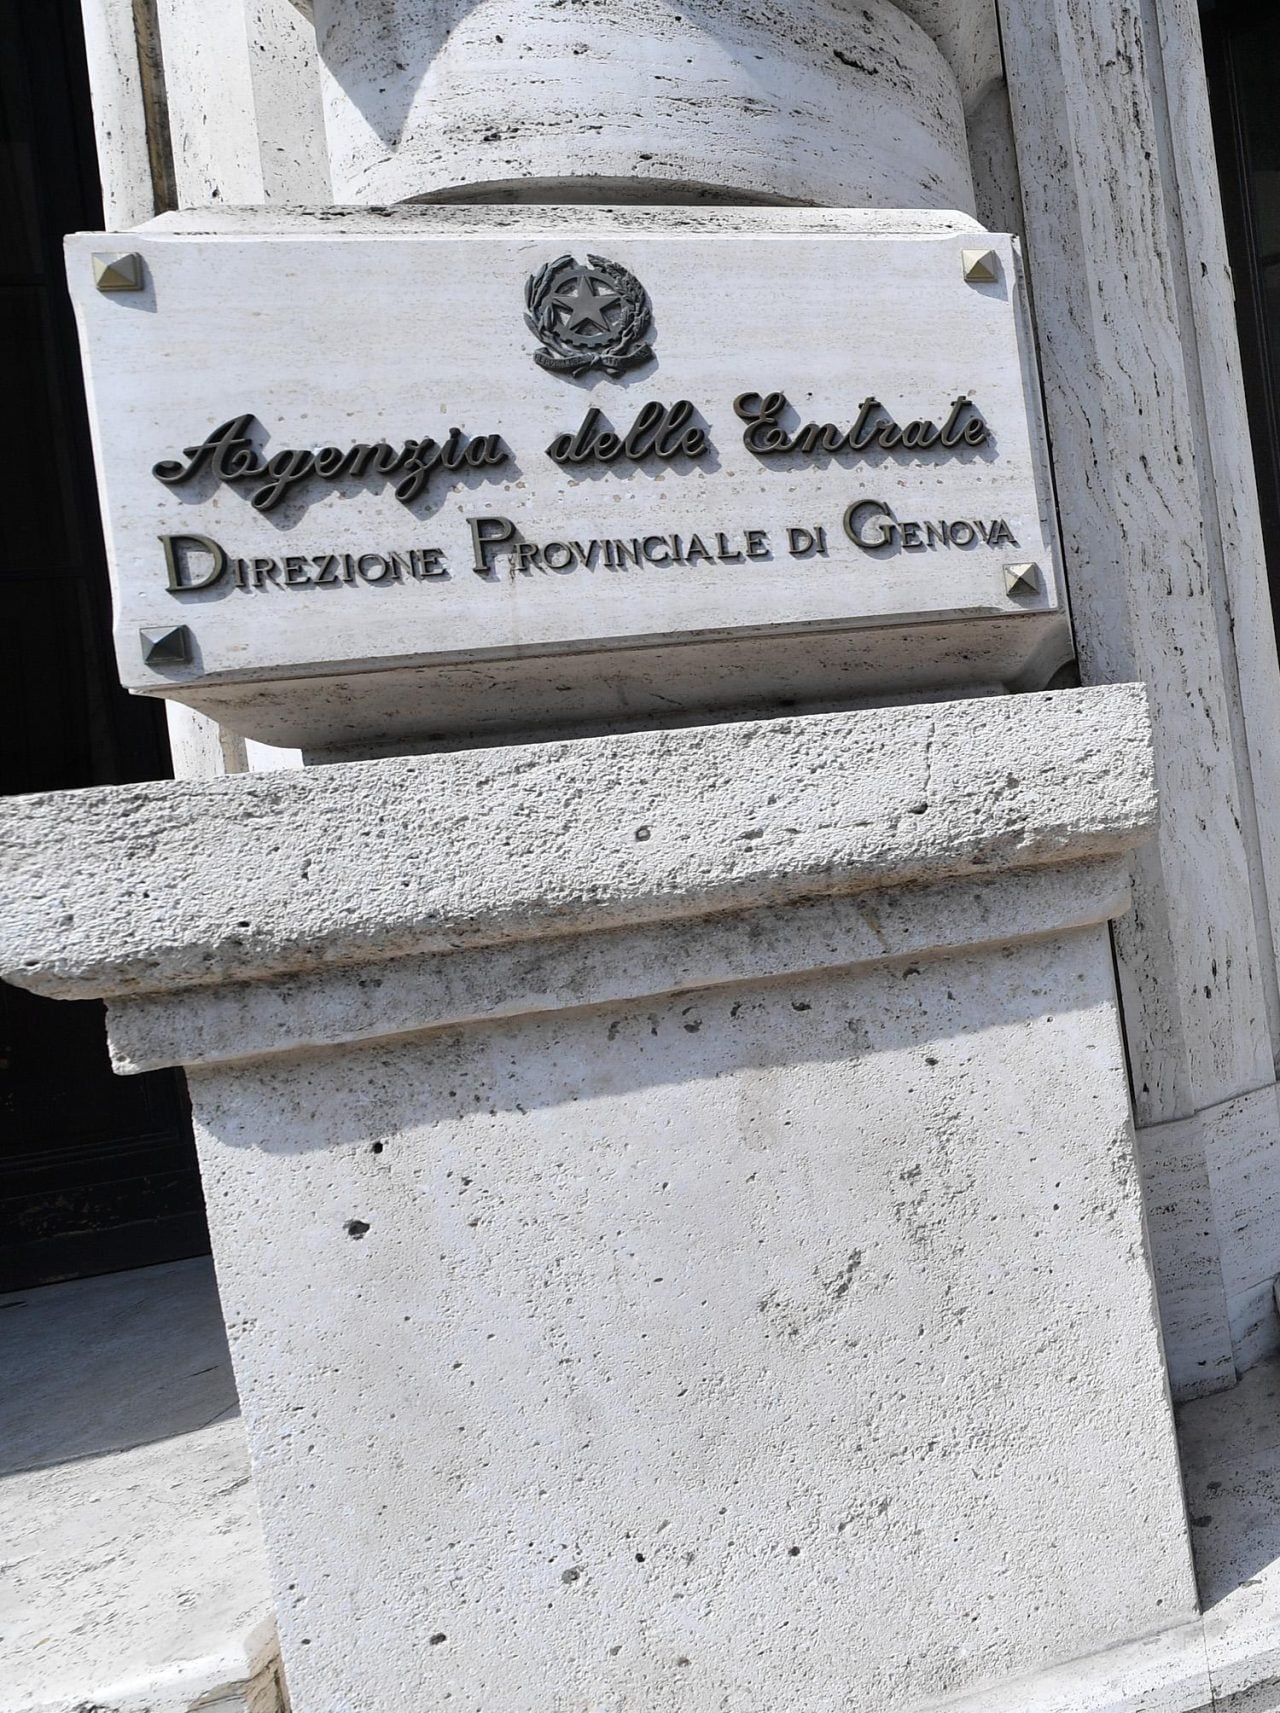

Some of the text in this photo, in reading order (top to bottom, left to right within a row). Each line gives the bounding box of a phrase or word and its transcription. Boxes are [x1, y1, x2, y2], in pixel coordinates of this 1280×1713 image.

[152, 391, 988, 512] Agenzia delle Entrate
[157, 499, 1019, 593] DIREZIONE PROVINCIALE DI GENOVA
